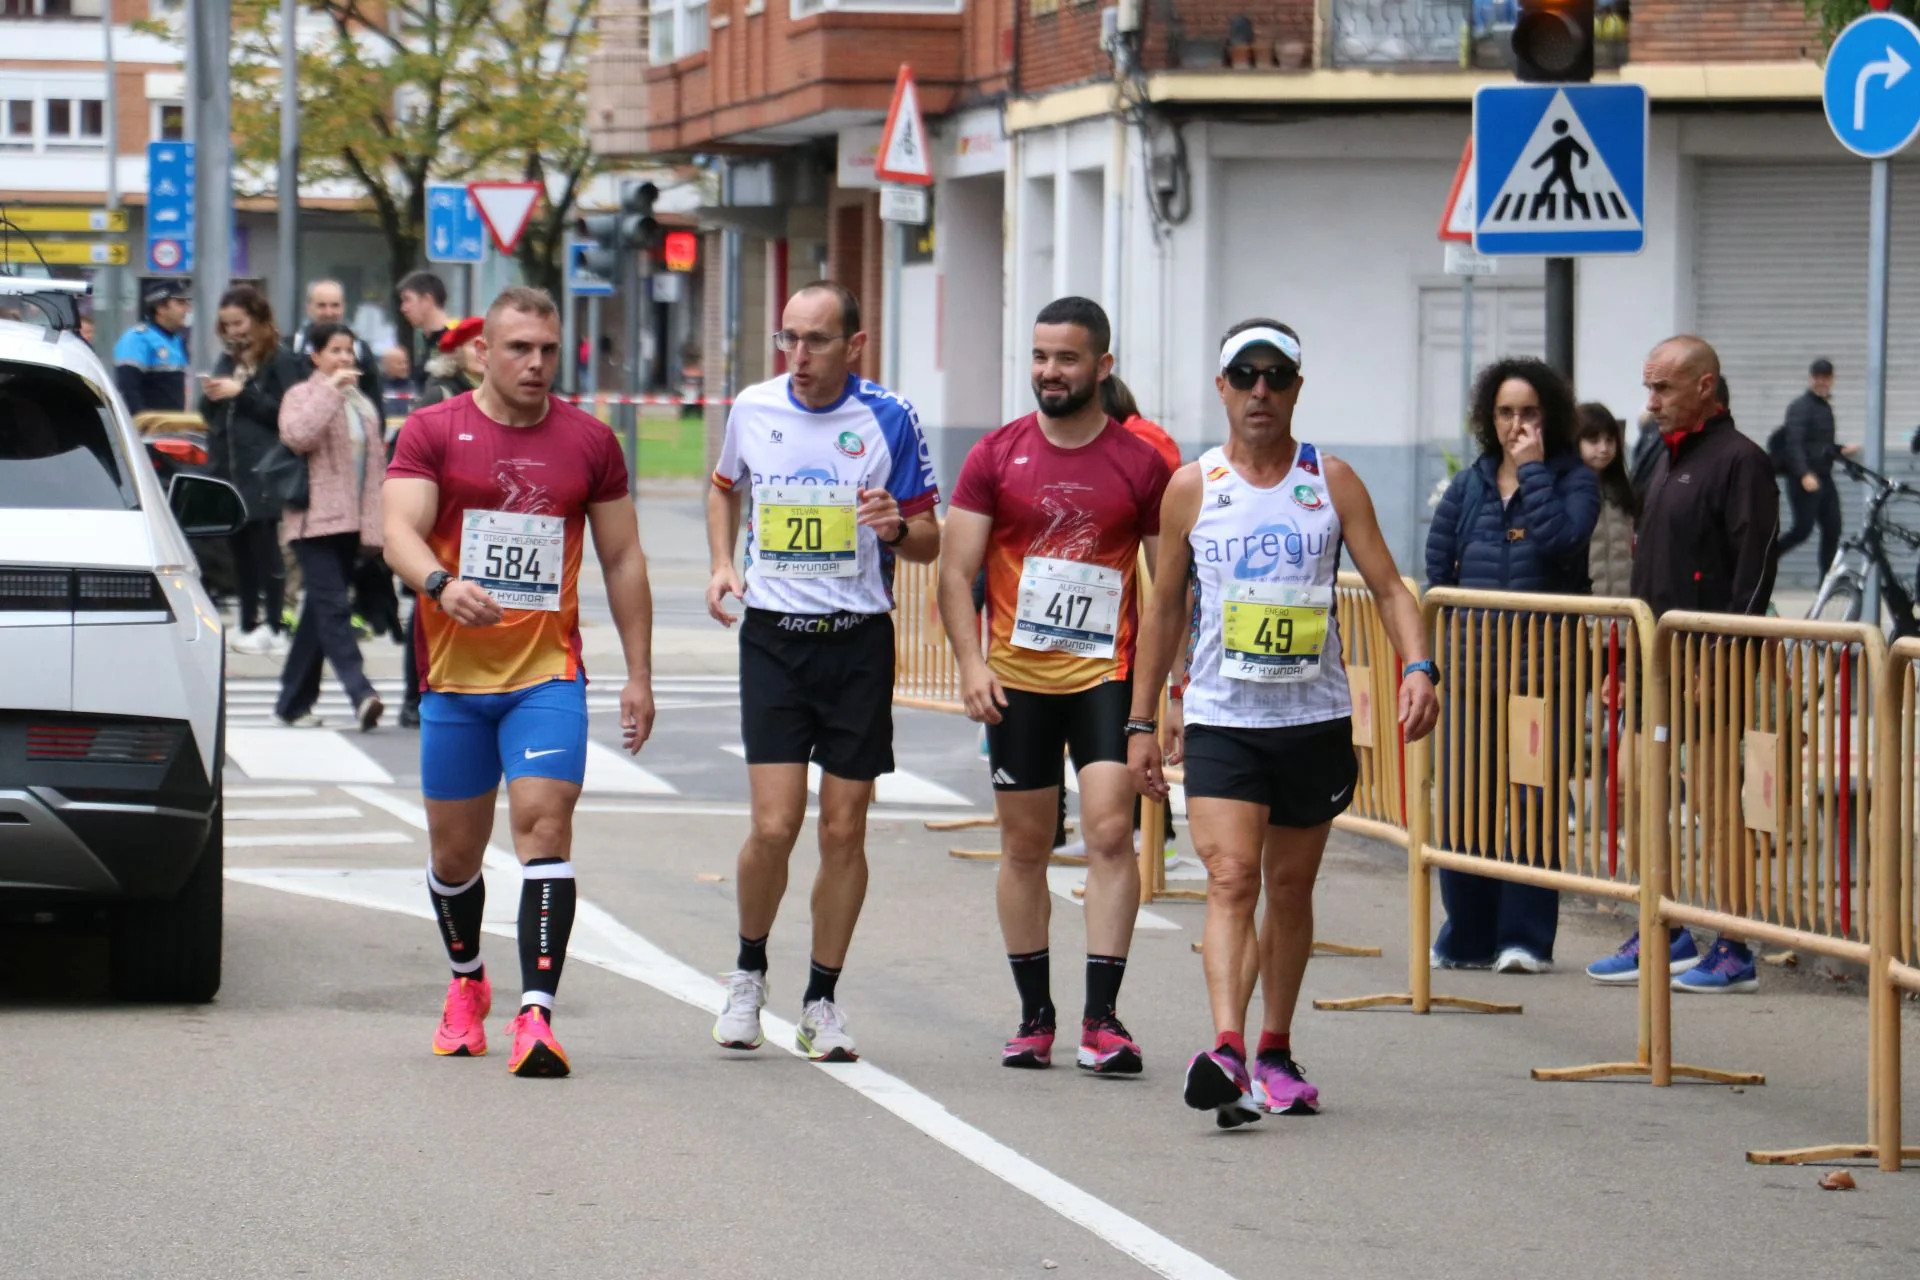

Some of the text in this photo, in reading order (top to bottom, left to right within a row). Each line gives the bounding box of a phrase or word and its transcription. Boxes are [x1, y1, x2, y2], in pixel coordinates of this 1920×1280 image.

[786, 517, 822, 551] 20
[1205, 526, 1331, 565] arregui
[484, 544, 541, 582] 584
[792, 562, 840, 572] HYUNDAI
[497, 591, 545, 603] HYUNDAI
[1044, 592, 1093, 629] 417
[1264, 607, 1290, 617] ENERO
[1050, 637, 1096, 651] HYUNDAI
[1253, 617, 1294, 654] 49
[1258, 666, 1304, 676] HYUNDAI
[540, 883, 551, 954] COMPRESSPORT
